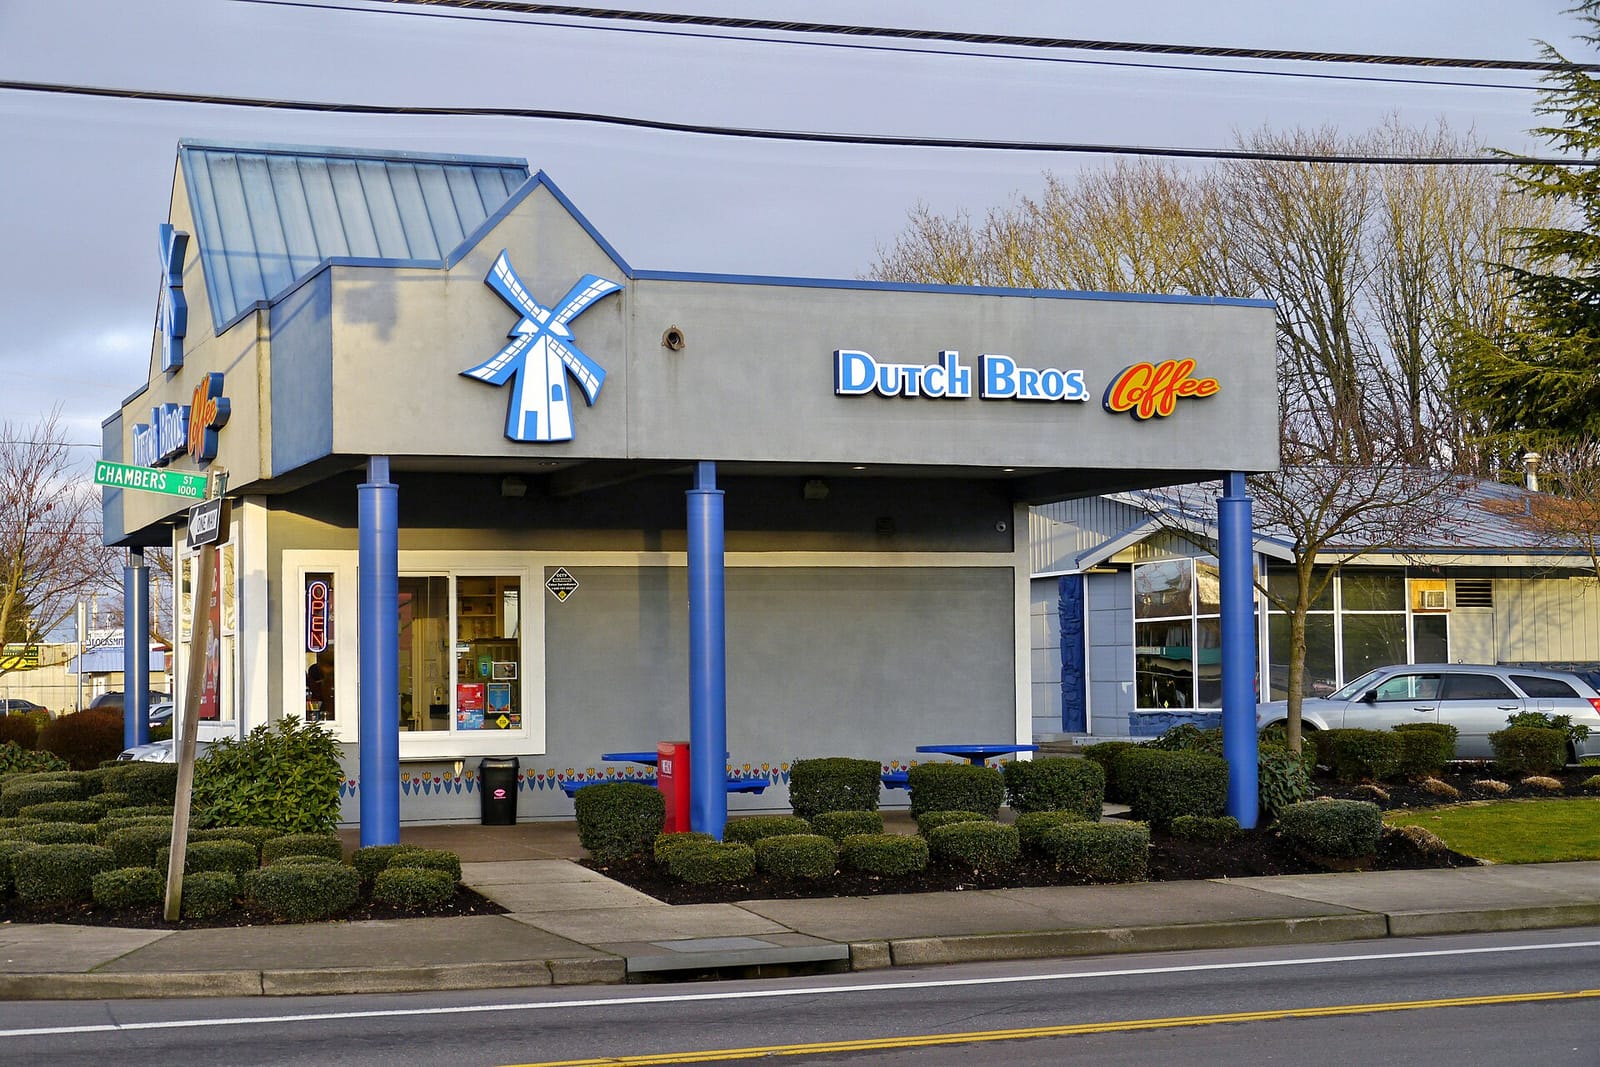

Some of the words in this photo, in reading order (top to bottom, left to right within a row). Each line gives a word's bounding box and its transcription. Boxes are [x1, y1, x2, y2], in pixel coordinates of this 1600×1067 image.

[1109, 358, 1221, 419] Coffee
[97, 464, 167, 490] CHAMBERS
[183, 475, 194, 485] ST
[177, 485, 197, 496] 1000
[197, 515, 207, 532] ONE
[207, 510, 217, 530] WAY
[310, 584, 325, 648] OPEN
[91, 638, 124, 646] LOCKSMIT
